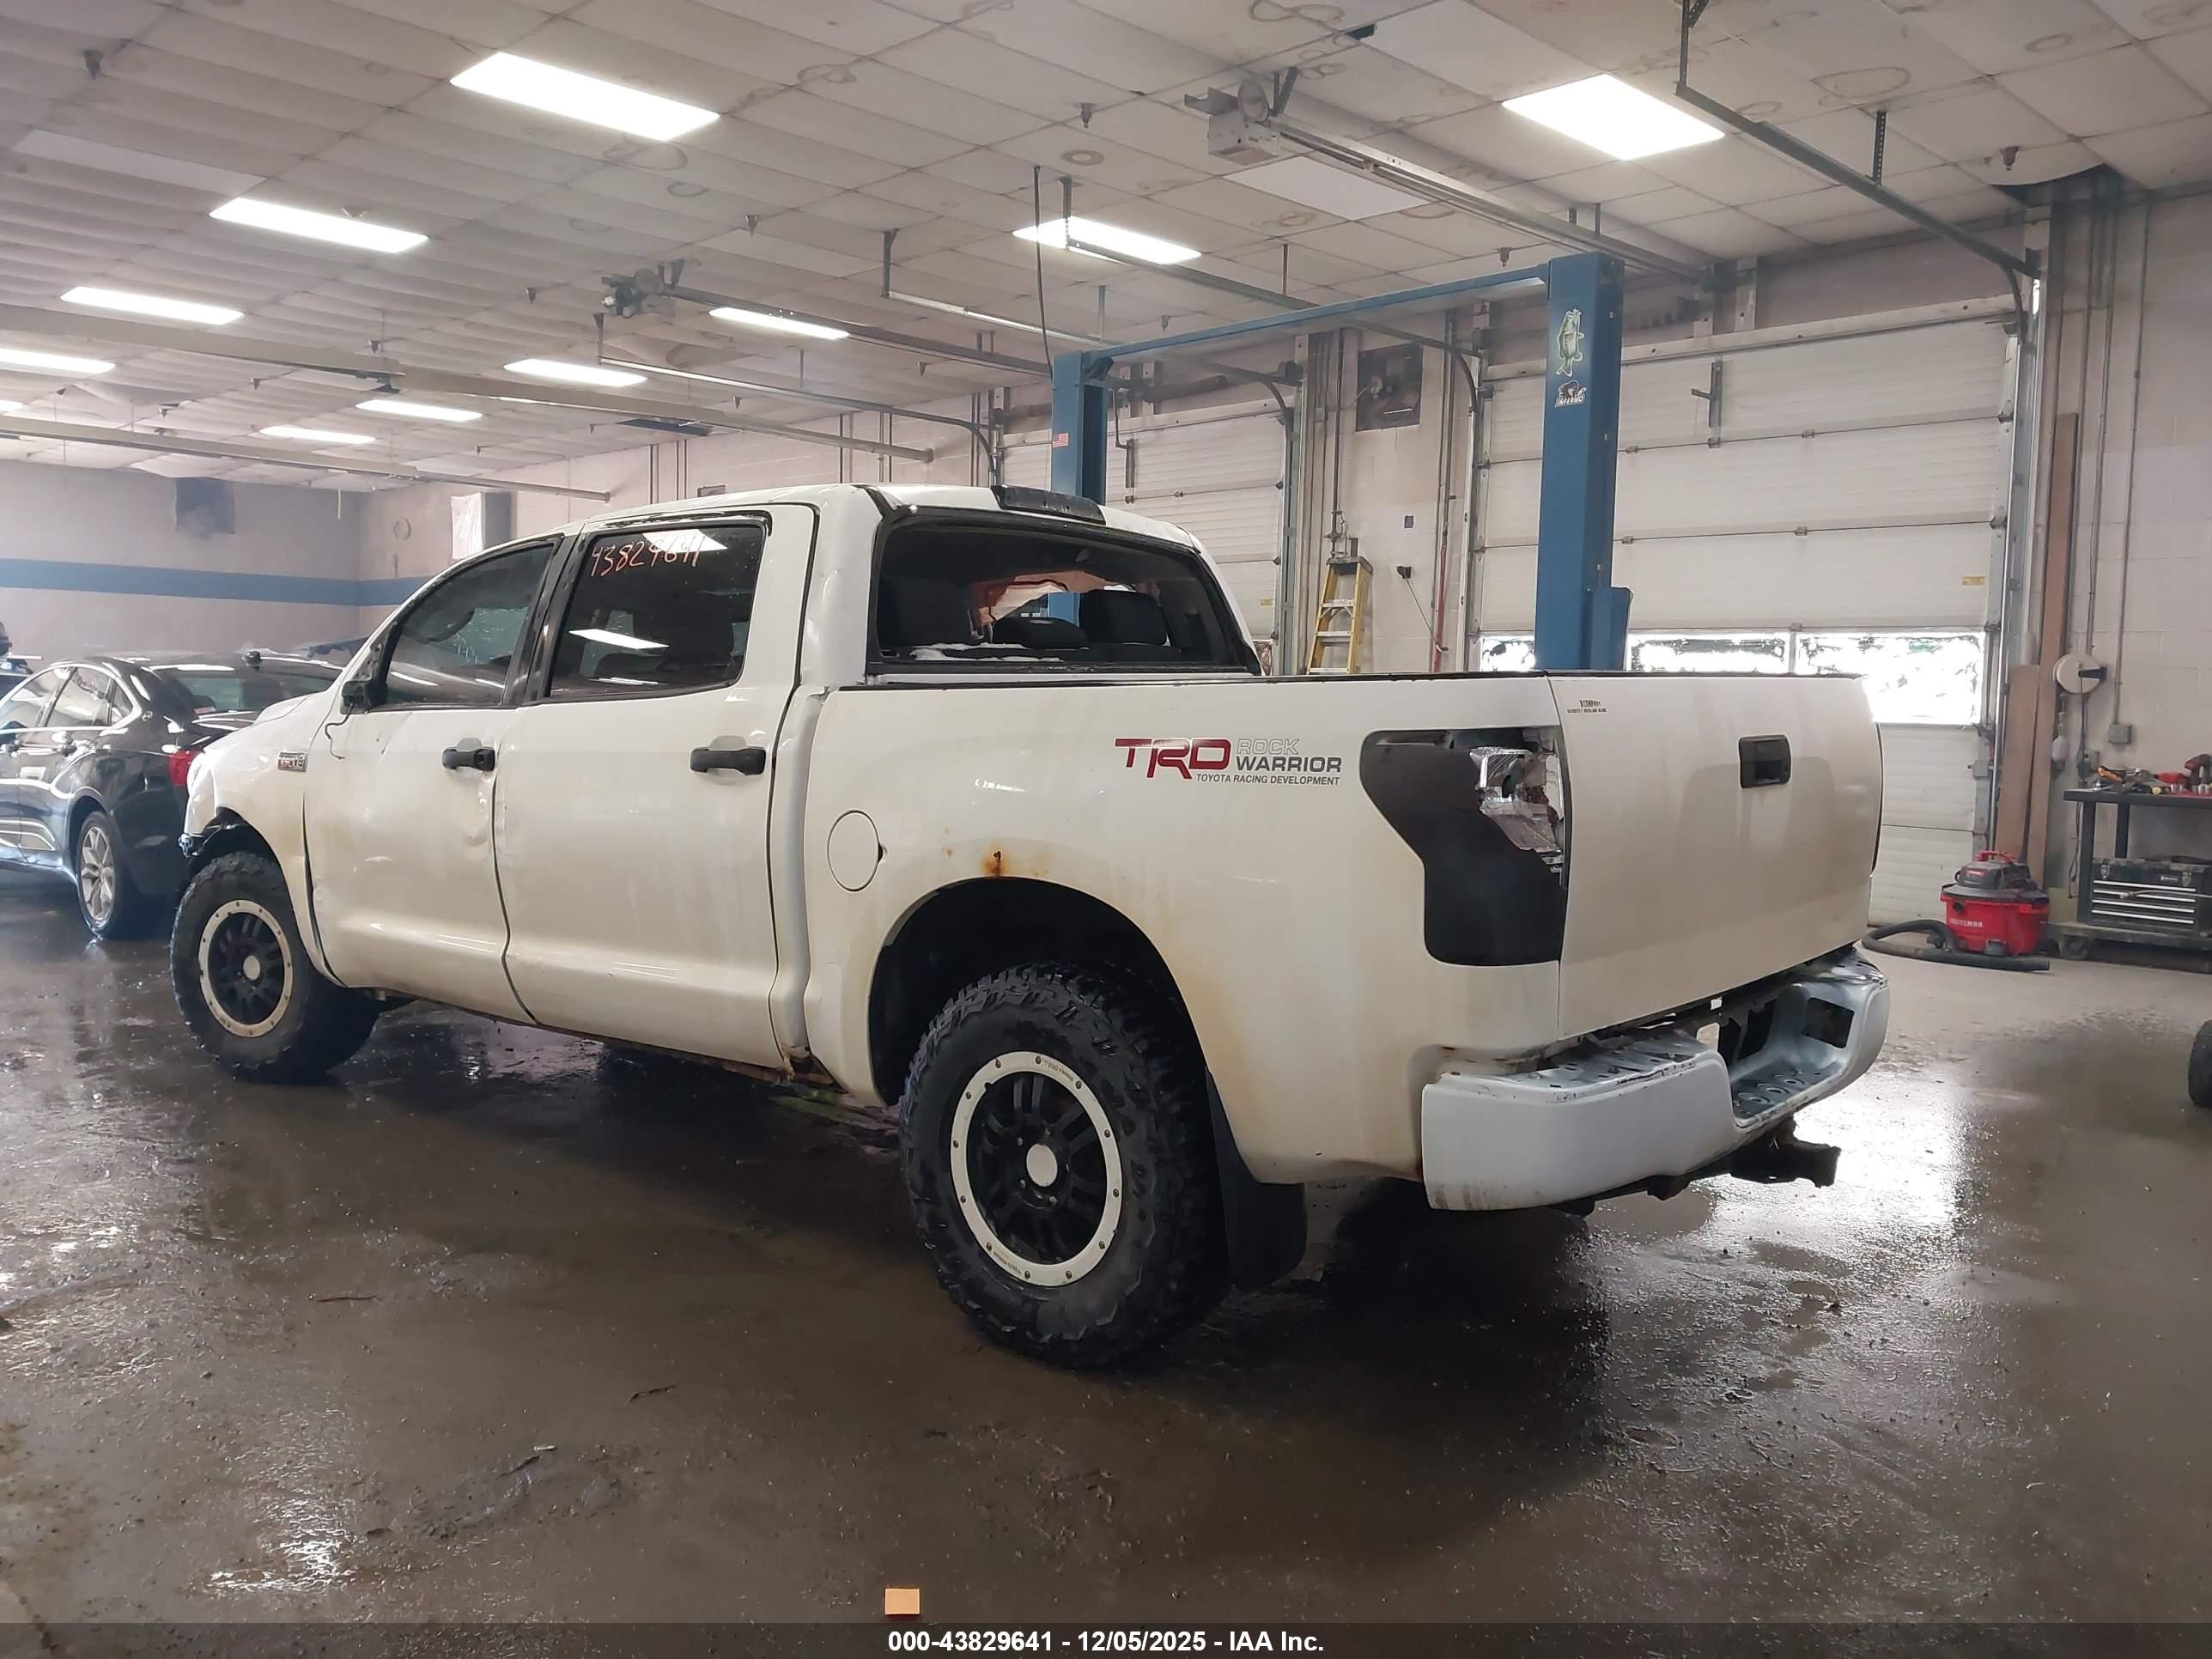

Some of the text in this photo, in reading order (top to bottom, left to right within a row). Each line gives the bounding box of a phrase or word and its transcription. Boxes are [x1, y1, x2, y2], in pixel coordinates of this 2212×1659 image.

[1237, 738, 1300, 755] ROCK
[1114, 738, 1231, 780] TRD
[1236, 756, 1342, 773] WARRIOR
[1196, 774, 1340, 786] TOYOTA RACING DEVELOPMENT
